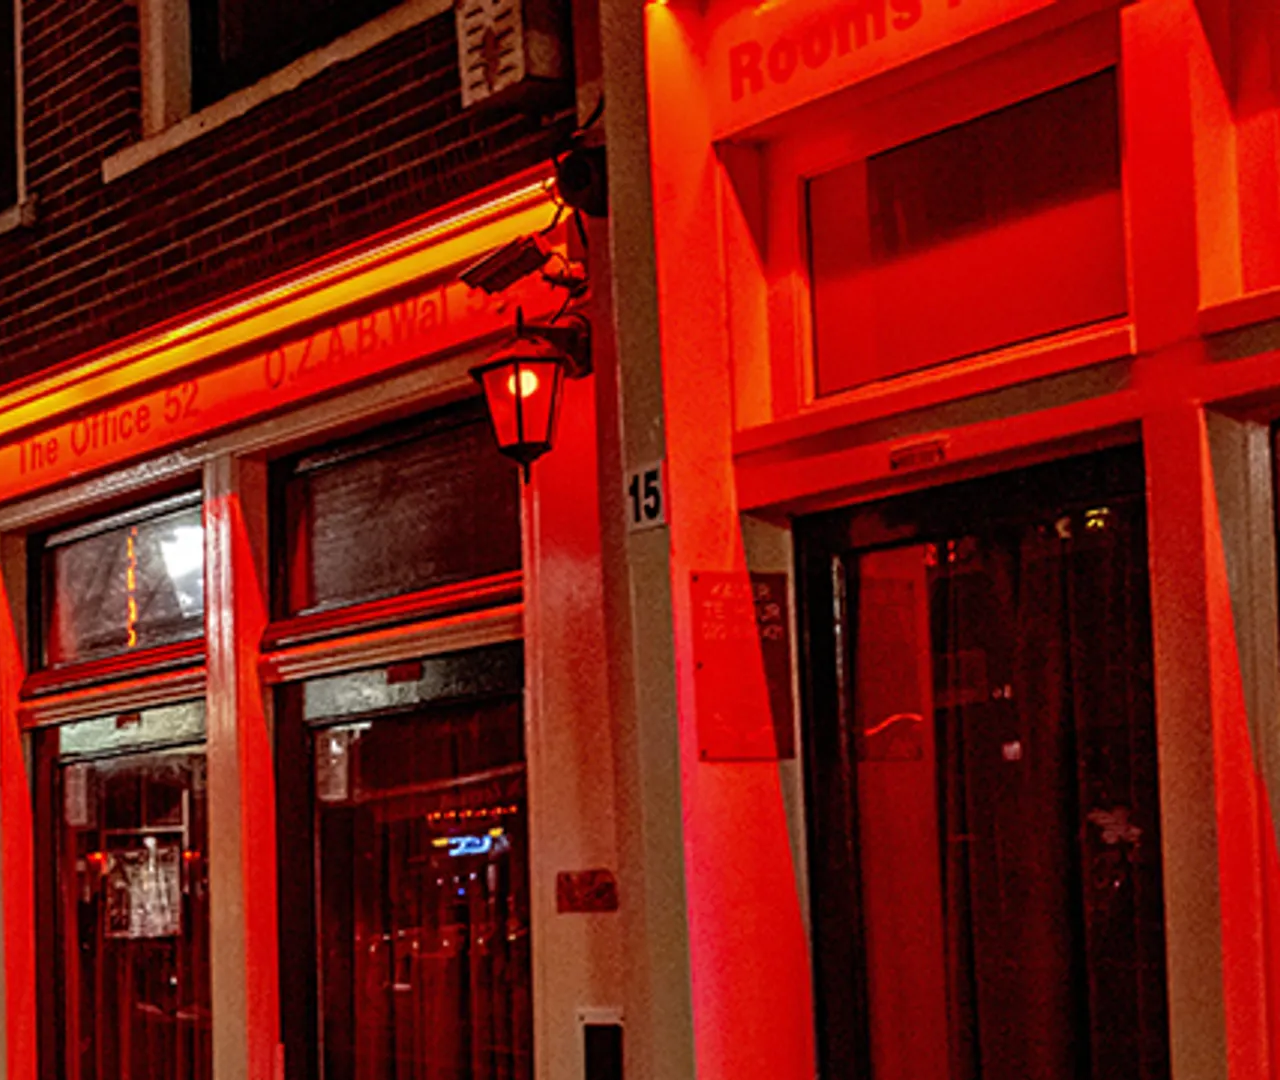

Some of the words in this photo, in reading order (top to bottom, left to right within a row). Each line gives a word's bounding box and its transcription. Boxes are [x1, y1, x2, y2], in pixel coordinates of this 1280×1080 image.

[18, 435, 59, 475] The
[69, 402, 151, 457] Office
[163, 379, 199, 424] 52
[629, 470, 661, 522] 15
